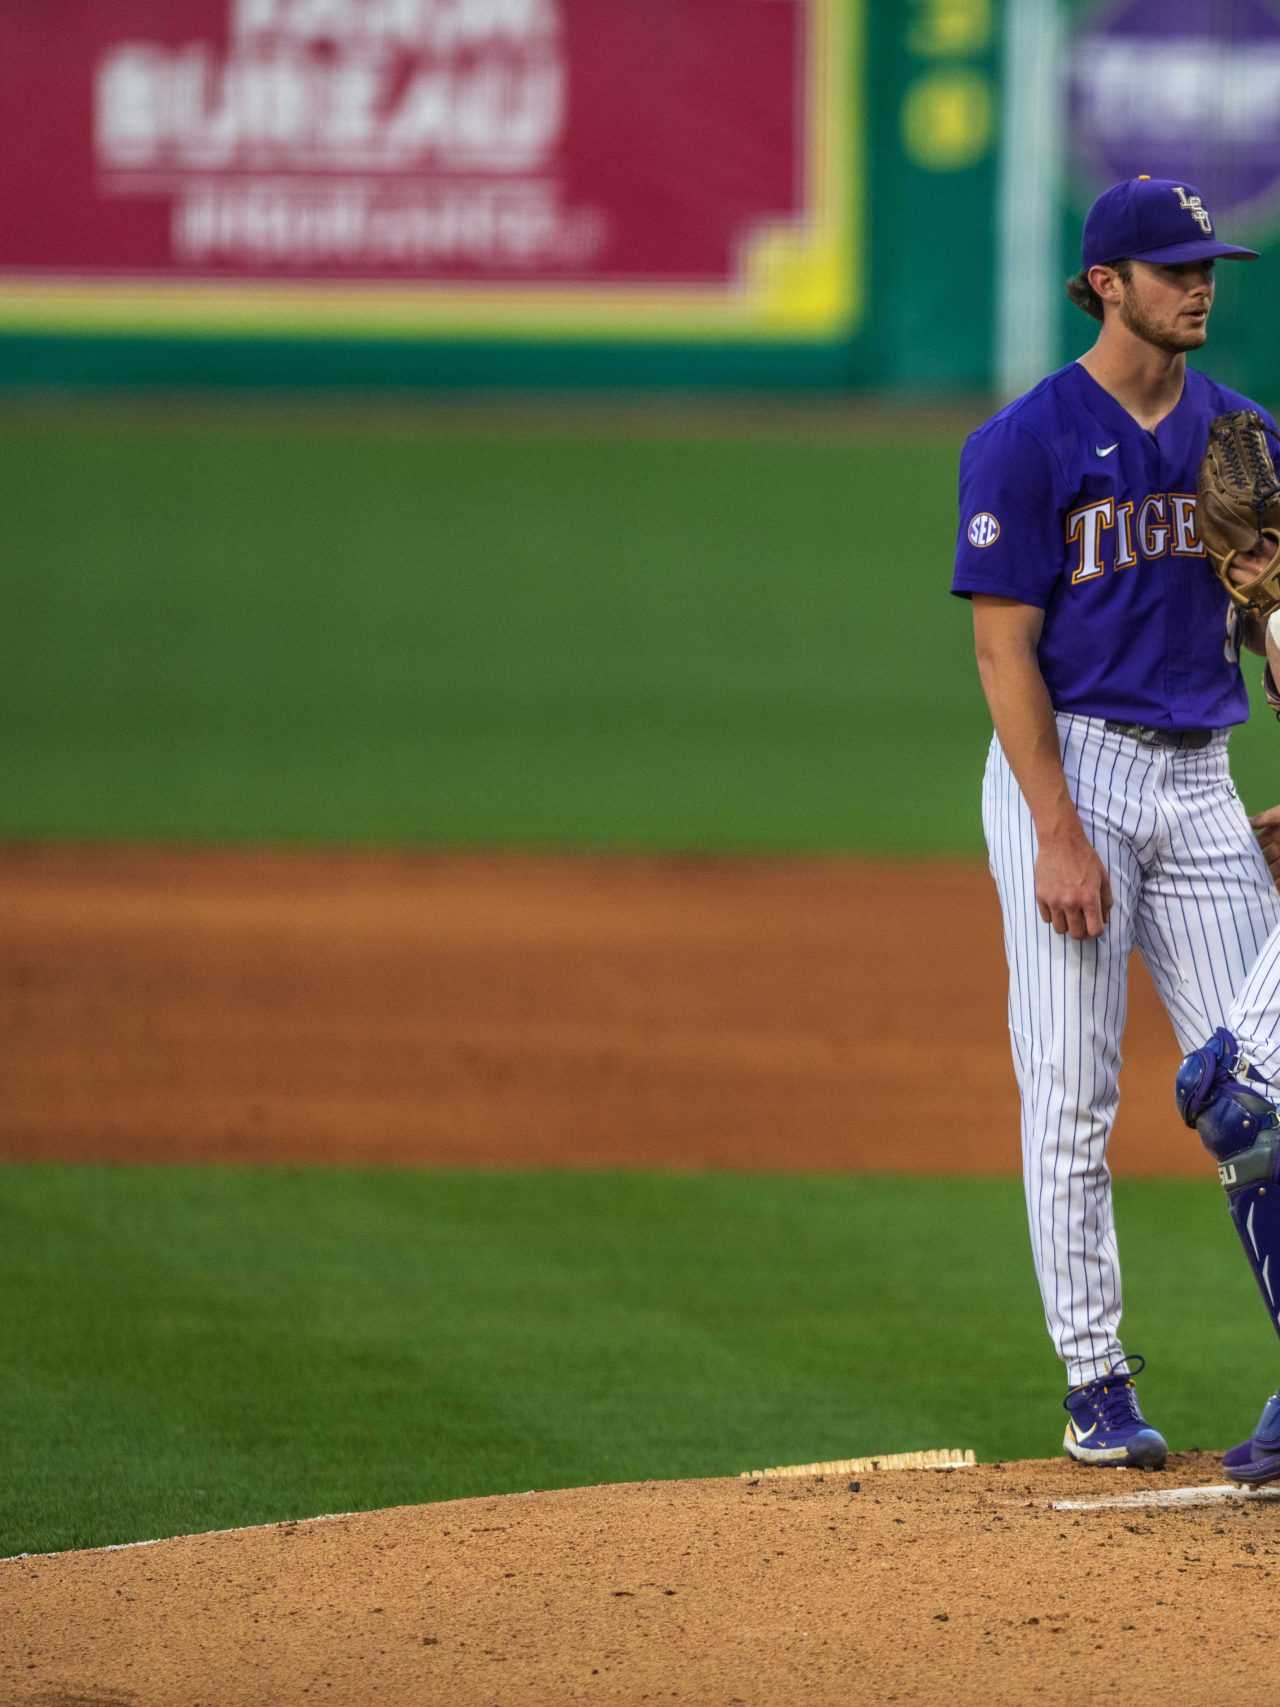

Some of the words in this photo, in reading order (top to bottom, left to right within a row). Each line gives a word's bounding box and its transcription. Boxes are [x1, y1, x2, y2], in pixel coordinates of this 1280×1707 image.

[1171, 186, 1212, 235] LSU
[970, 514, 997, 545] SEC
[1066, 492, 1209, 586] TIGE
